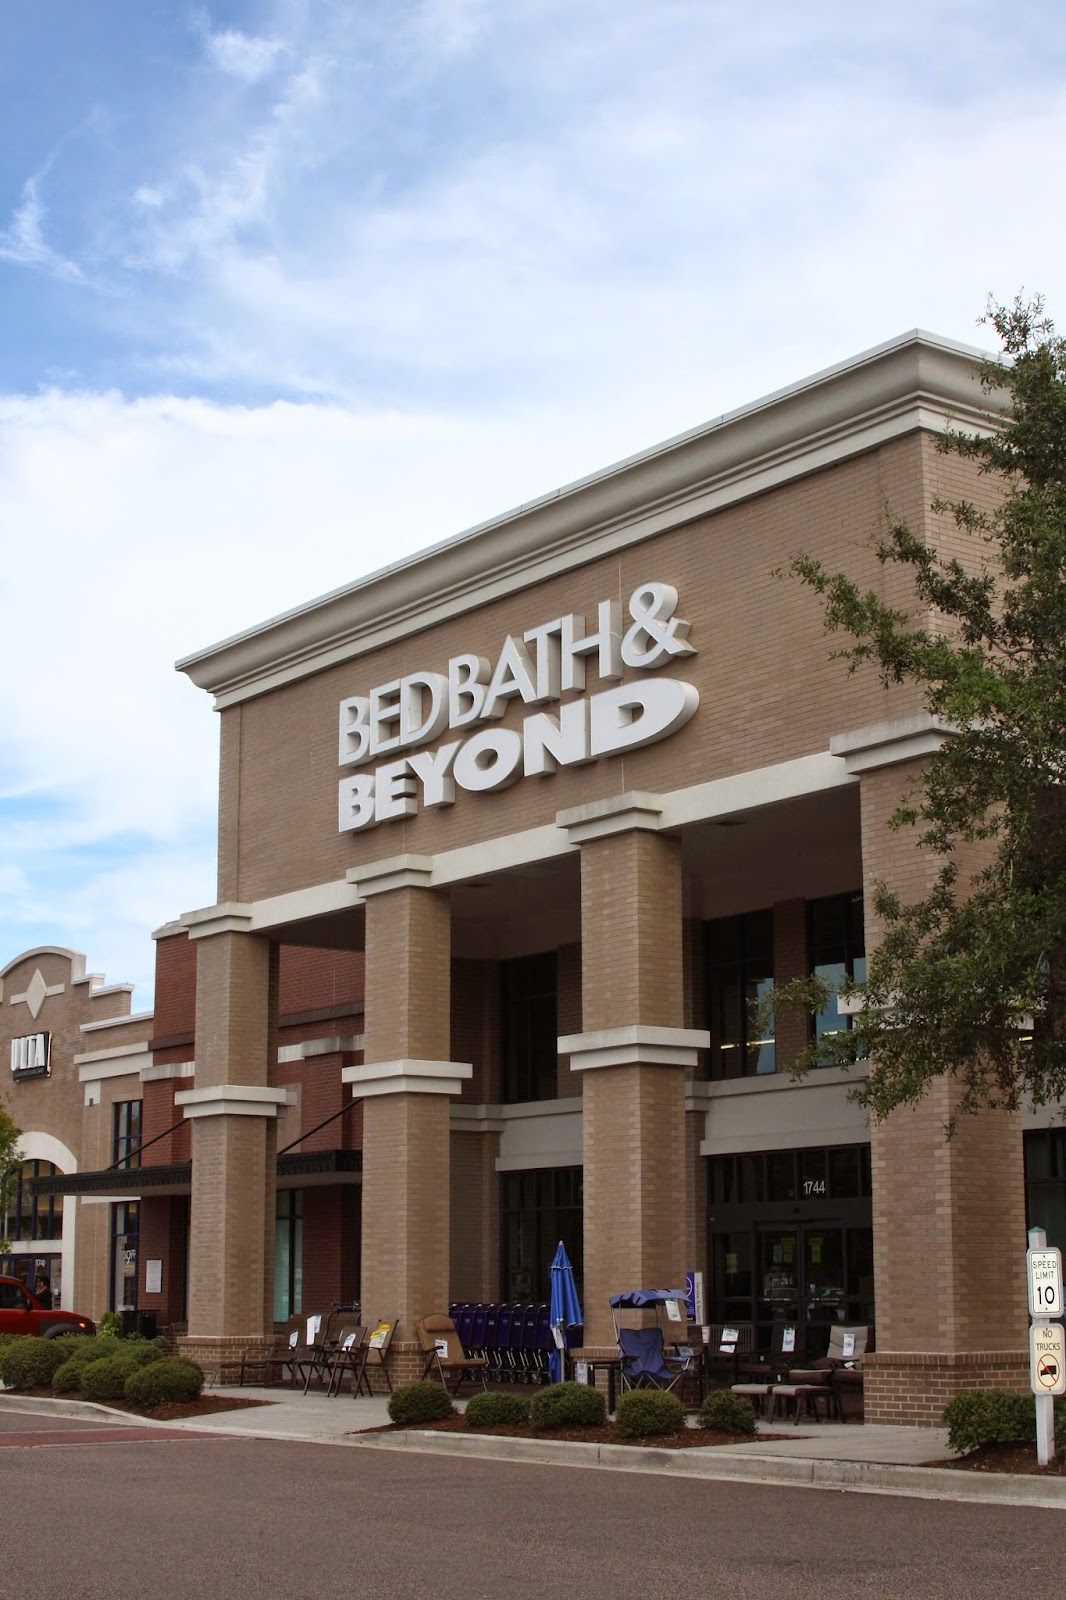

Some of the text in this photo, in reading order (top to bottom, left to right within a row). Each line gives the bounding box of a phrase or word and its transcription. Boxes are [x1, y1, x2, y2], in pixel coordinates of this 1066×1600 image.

[339, 582, 698, 767] BED BATH &
[339, 678, 700, 832] BEYOND
[803, 1180, 826, 1194] 1744
[1033, 1260, 1057, 1269] SPEED
[1036, 1271, 1055, 1280] LIMIT
[1037, 1286, 1055, 1305] 10
[1042, 1329, 1053, 1338] NO
[1036, 1343, 1061, 1351] TRUCKS
